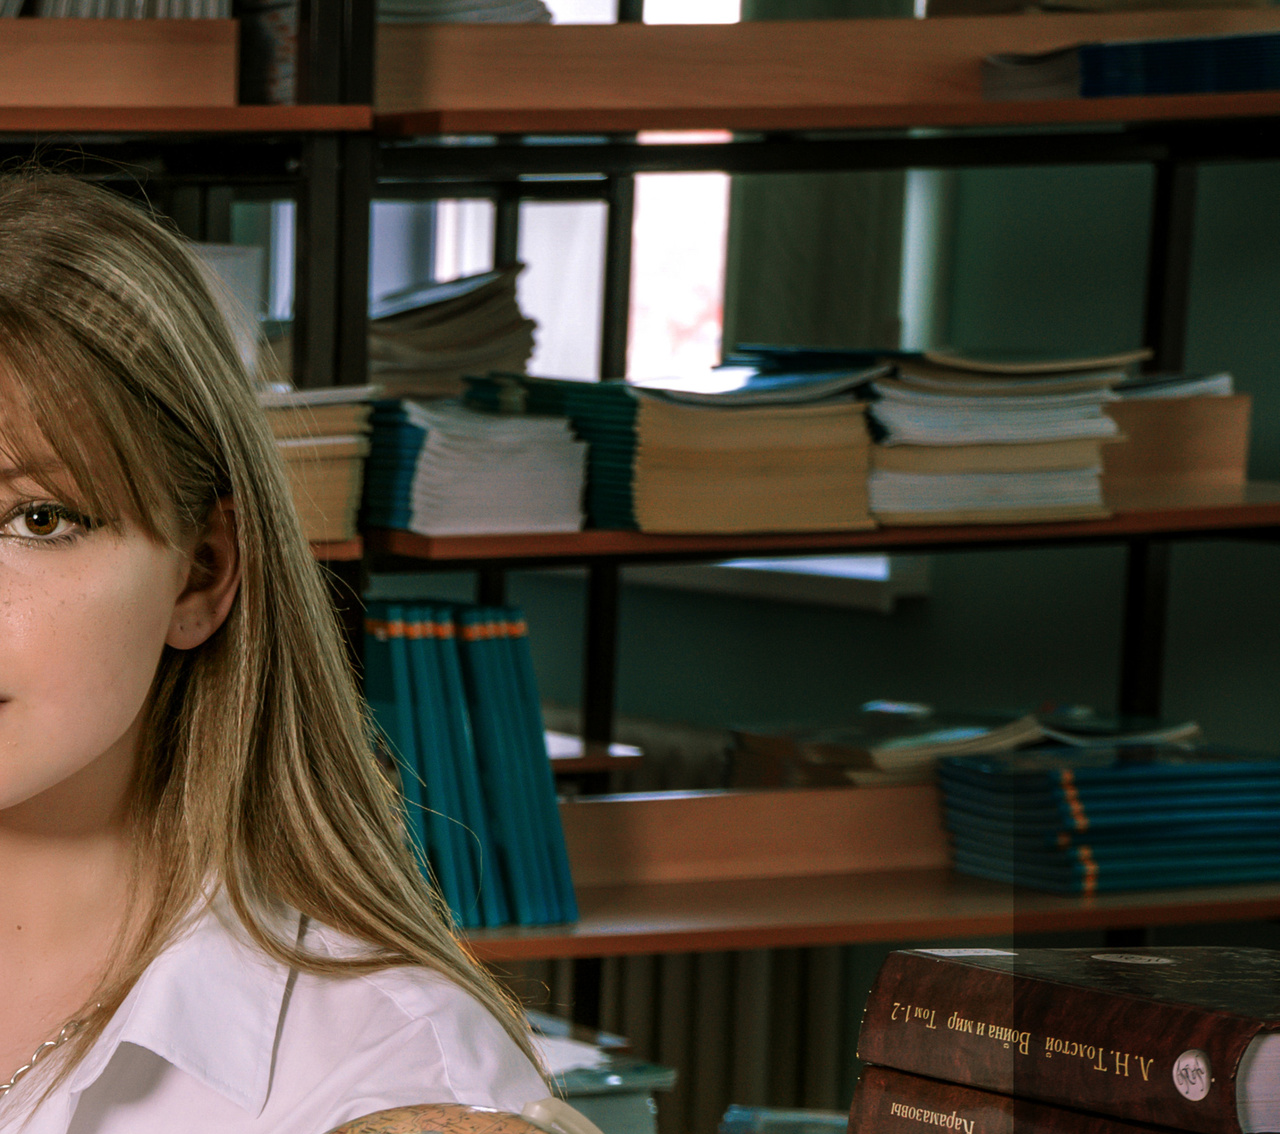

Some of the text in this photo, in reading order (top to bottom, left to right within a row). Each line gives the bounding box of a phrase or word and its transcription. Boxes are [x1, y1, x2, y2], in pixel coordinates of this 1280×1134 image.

[890, 1001, 912, 1023] 1-2
[913, 1006, 937, 1030] Том
[946, 1011, 974, 1034] мир
[976, 1022, 986, 1036] и
[987, 1023, 1031, 1056] Война
[1044, 1036, 1108, 1072] Толстой
